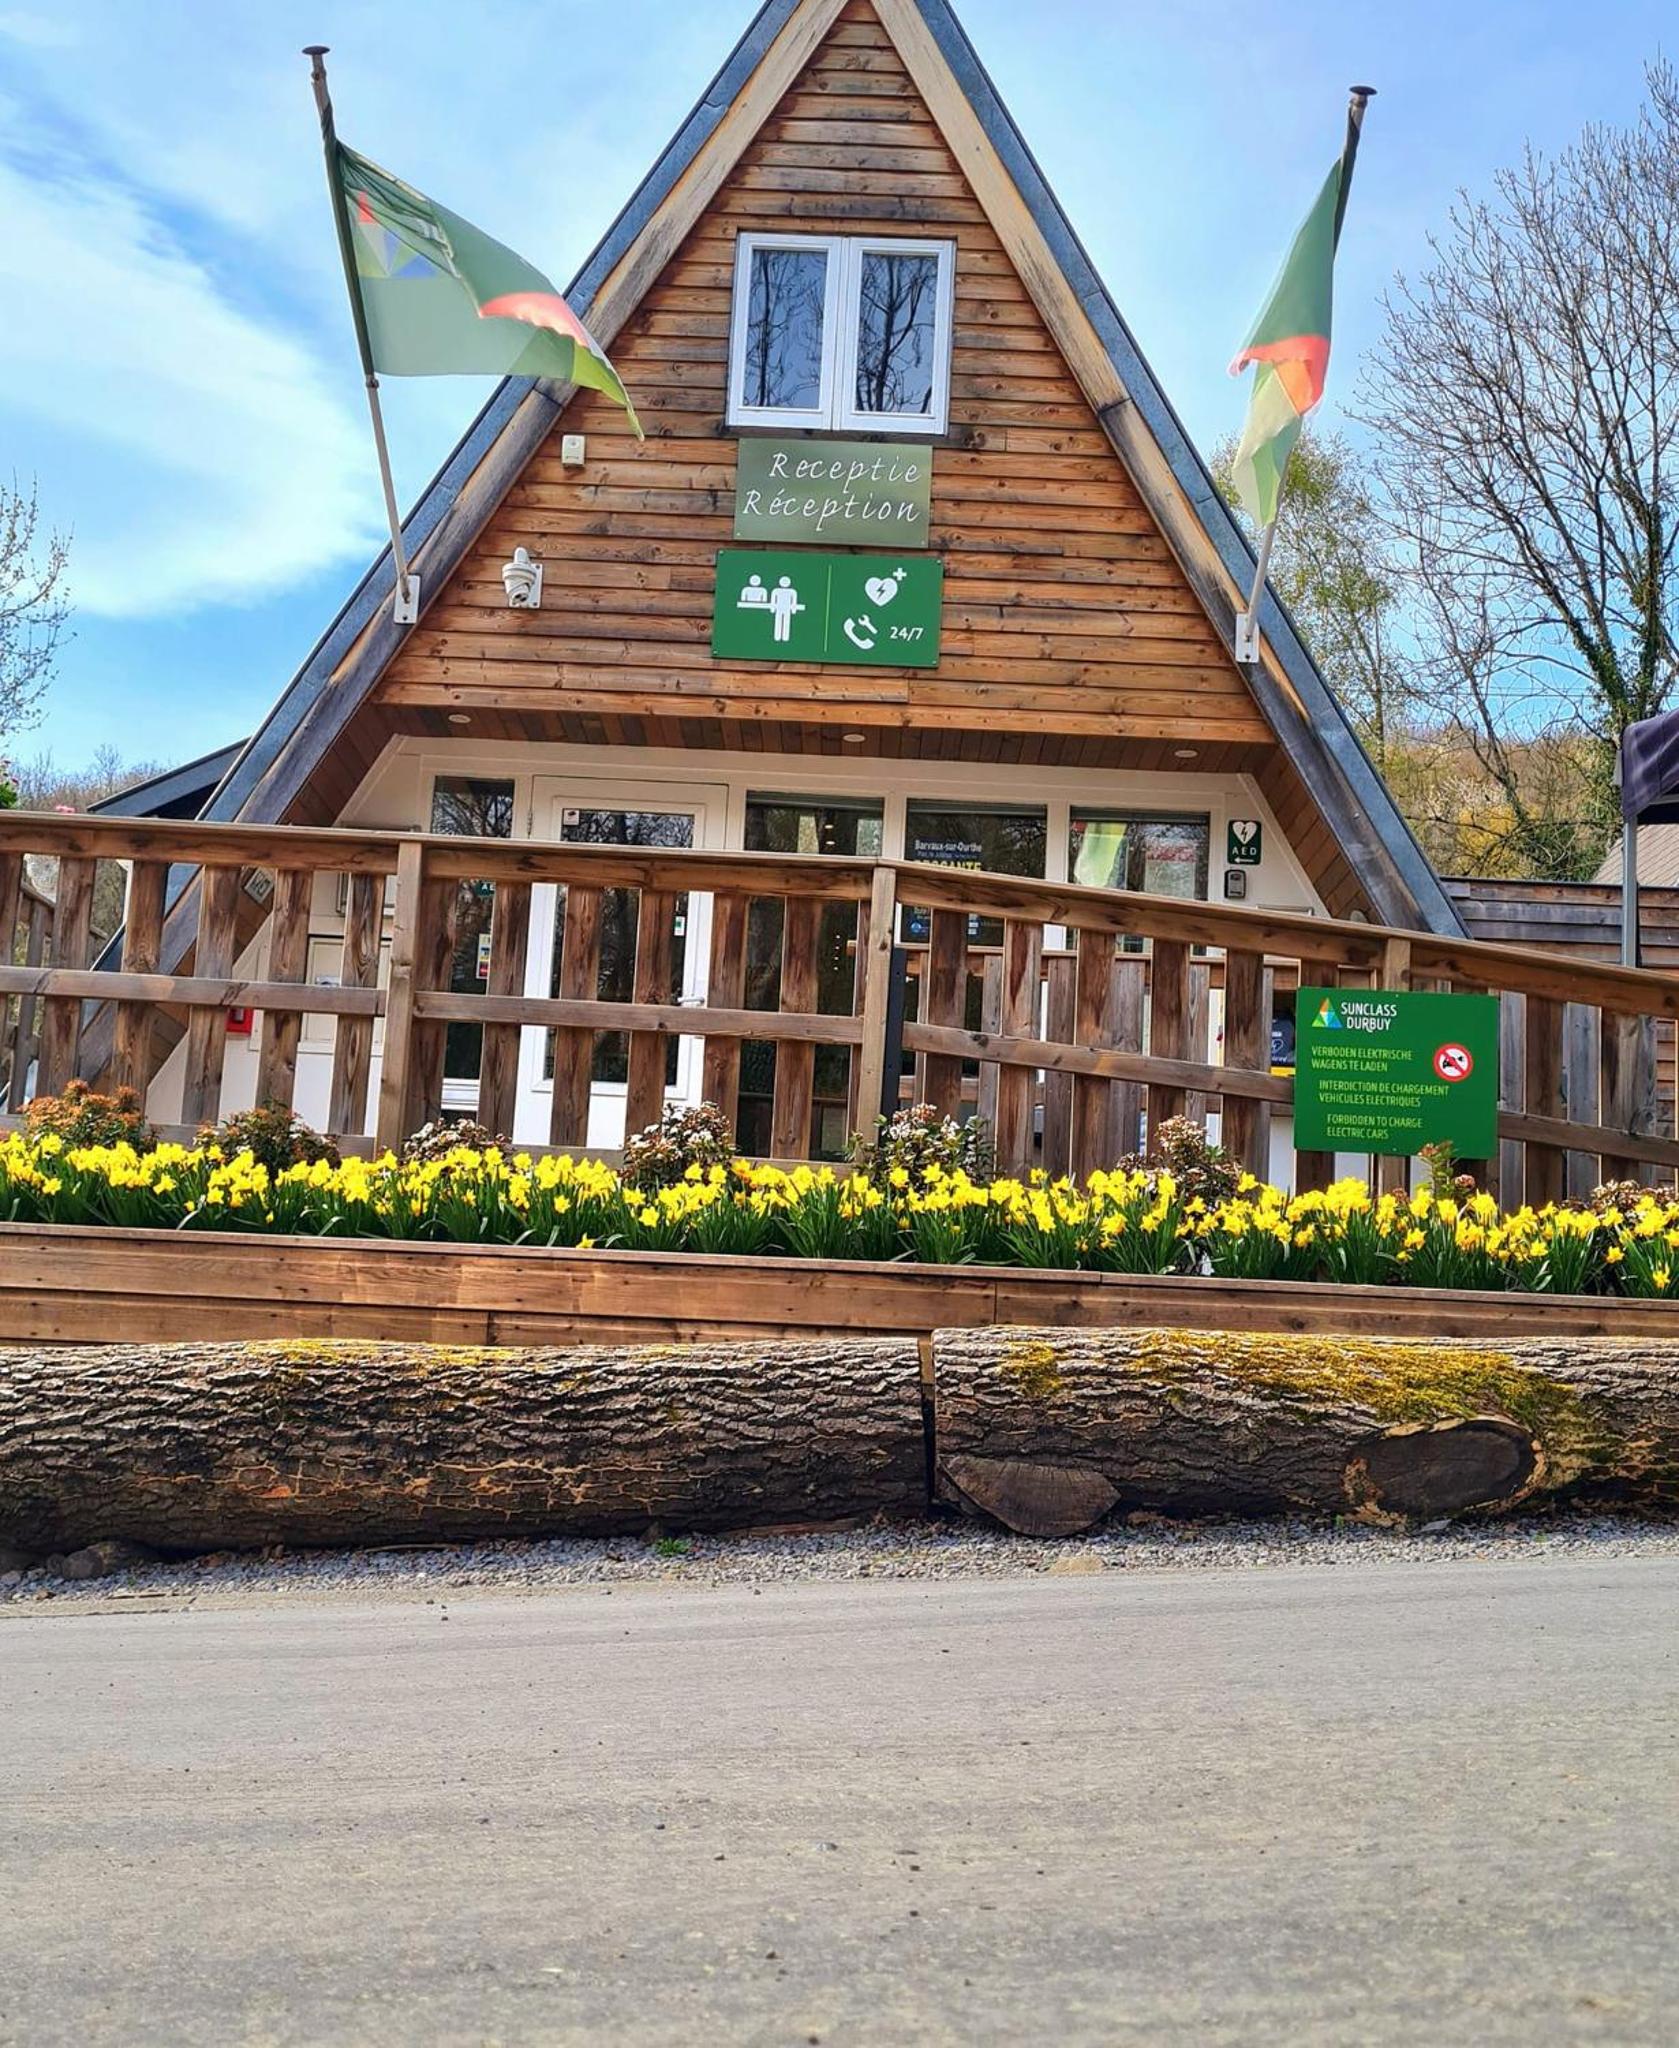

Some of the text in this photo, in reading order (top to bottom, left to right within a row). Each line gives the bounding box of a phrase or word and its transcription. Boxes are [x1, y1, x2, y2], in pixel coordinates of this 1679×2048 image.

[769, 452, 921, 494] Receptie
[742, 489, 920, 532] Réception
[889, 626, 924, 642] 24/7
[1232, 847, 1257, 856] AED
[1341, 1002, 1397, 1017] SUNCLASS
[1346, 1016, 1391, 1033] DURBUY
[1312, 1046, 1412, 1060] VERBODEN ELEKTRISCHE
[1312, 1058, 1388, 1072] WAGENS TE LADEN
[1319, 1080, 1450, 1096] INTERDICTION DE CHARGEMENT
[1319, 1092, 1421, 1107] VEHICULES ELECTRIQUES
[1327, 1114, 1422, 1128] FORBIDDEN TO CHARGE
[1327, 1126, 1389, 1139] ELECTRIC CARS
